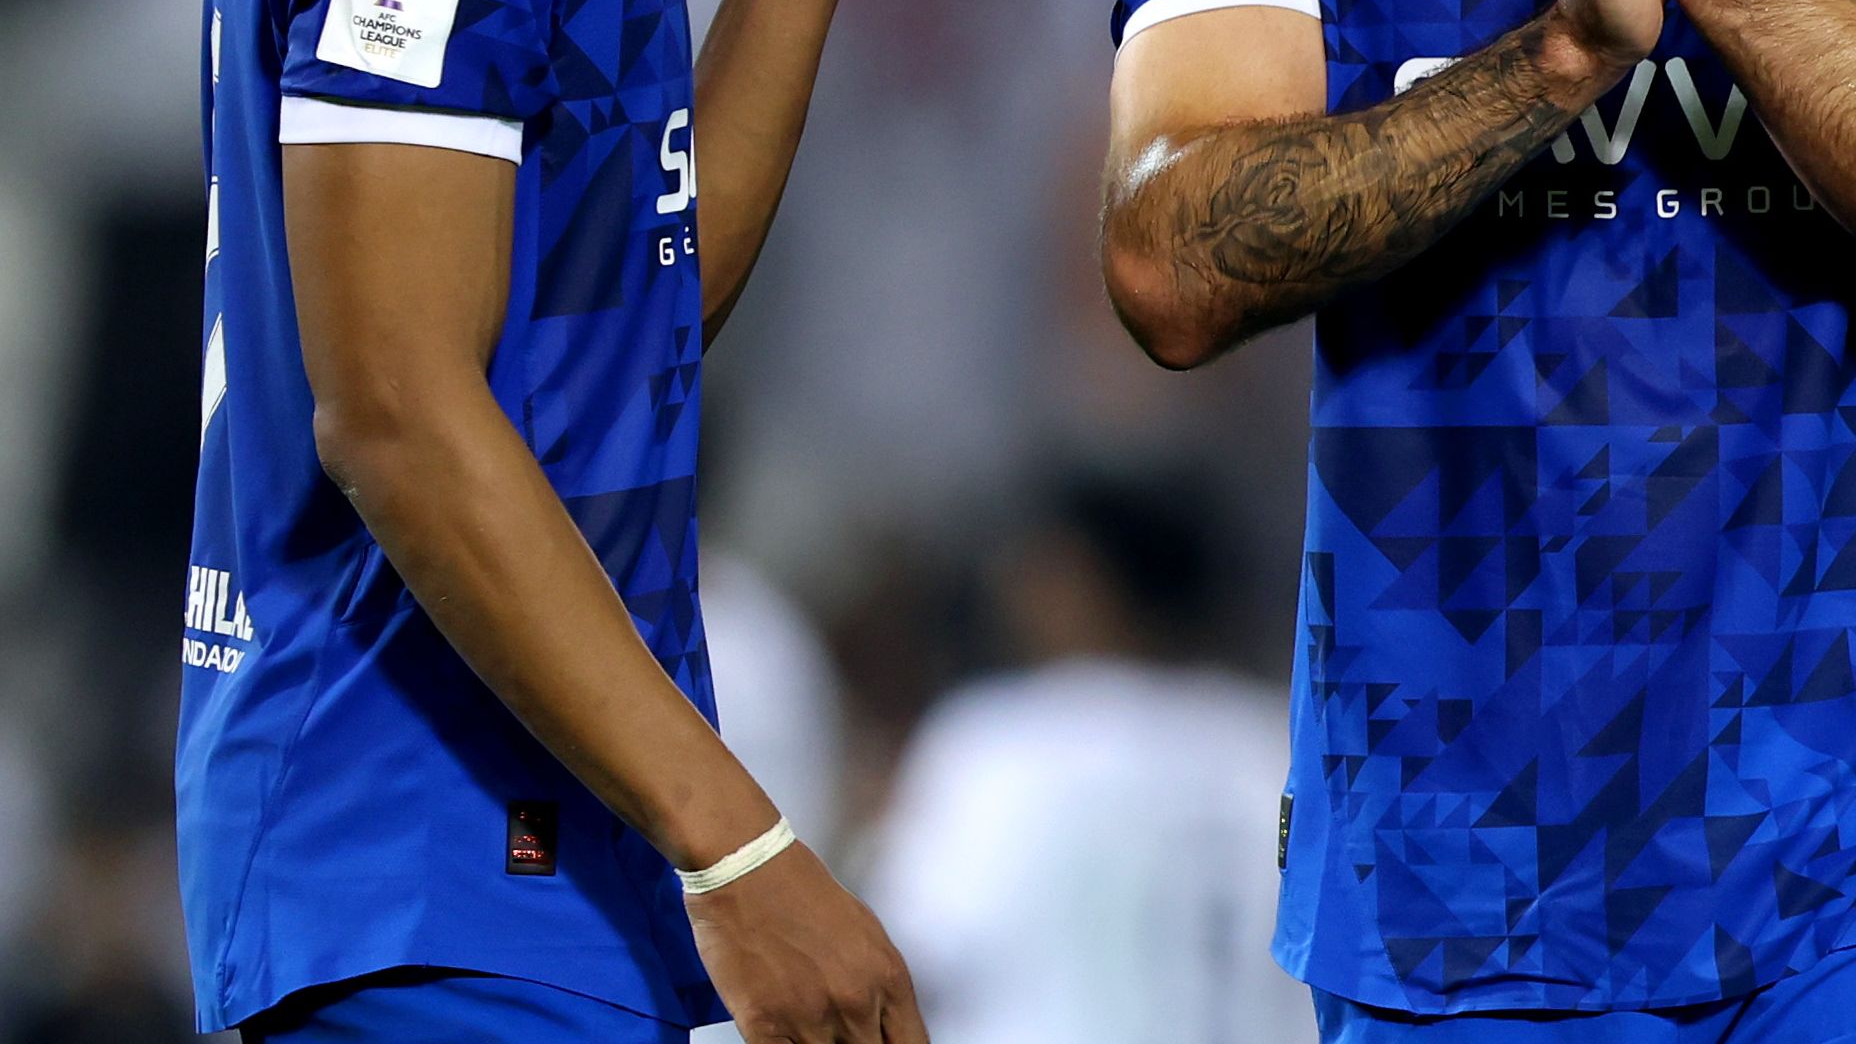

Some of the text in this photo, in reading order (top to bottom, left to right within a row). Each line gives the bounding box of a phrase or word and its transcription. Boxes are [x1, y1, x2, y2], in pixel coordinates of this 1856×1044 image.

[352, 15, 422, 40] CHAMPIONS
[378, 12, 397, 23] AFC
[360, 29, 407, 49] LEAGUE
[364, 42, 400, 59] ELITE
[1498, 185, 1816, 220] MES GROU
